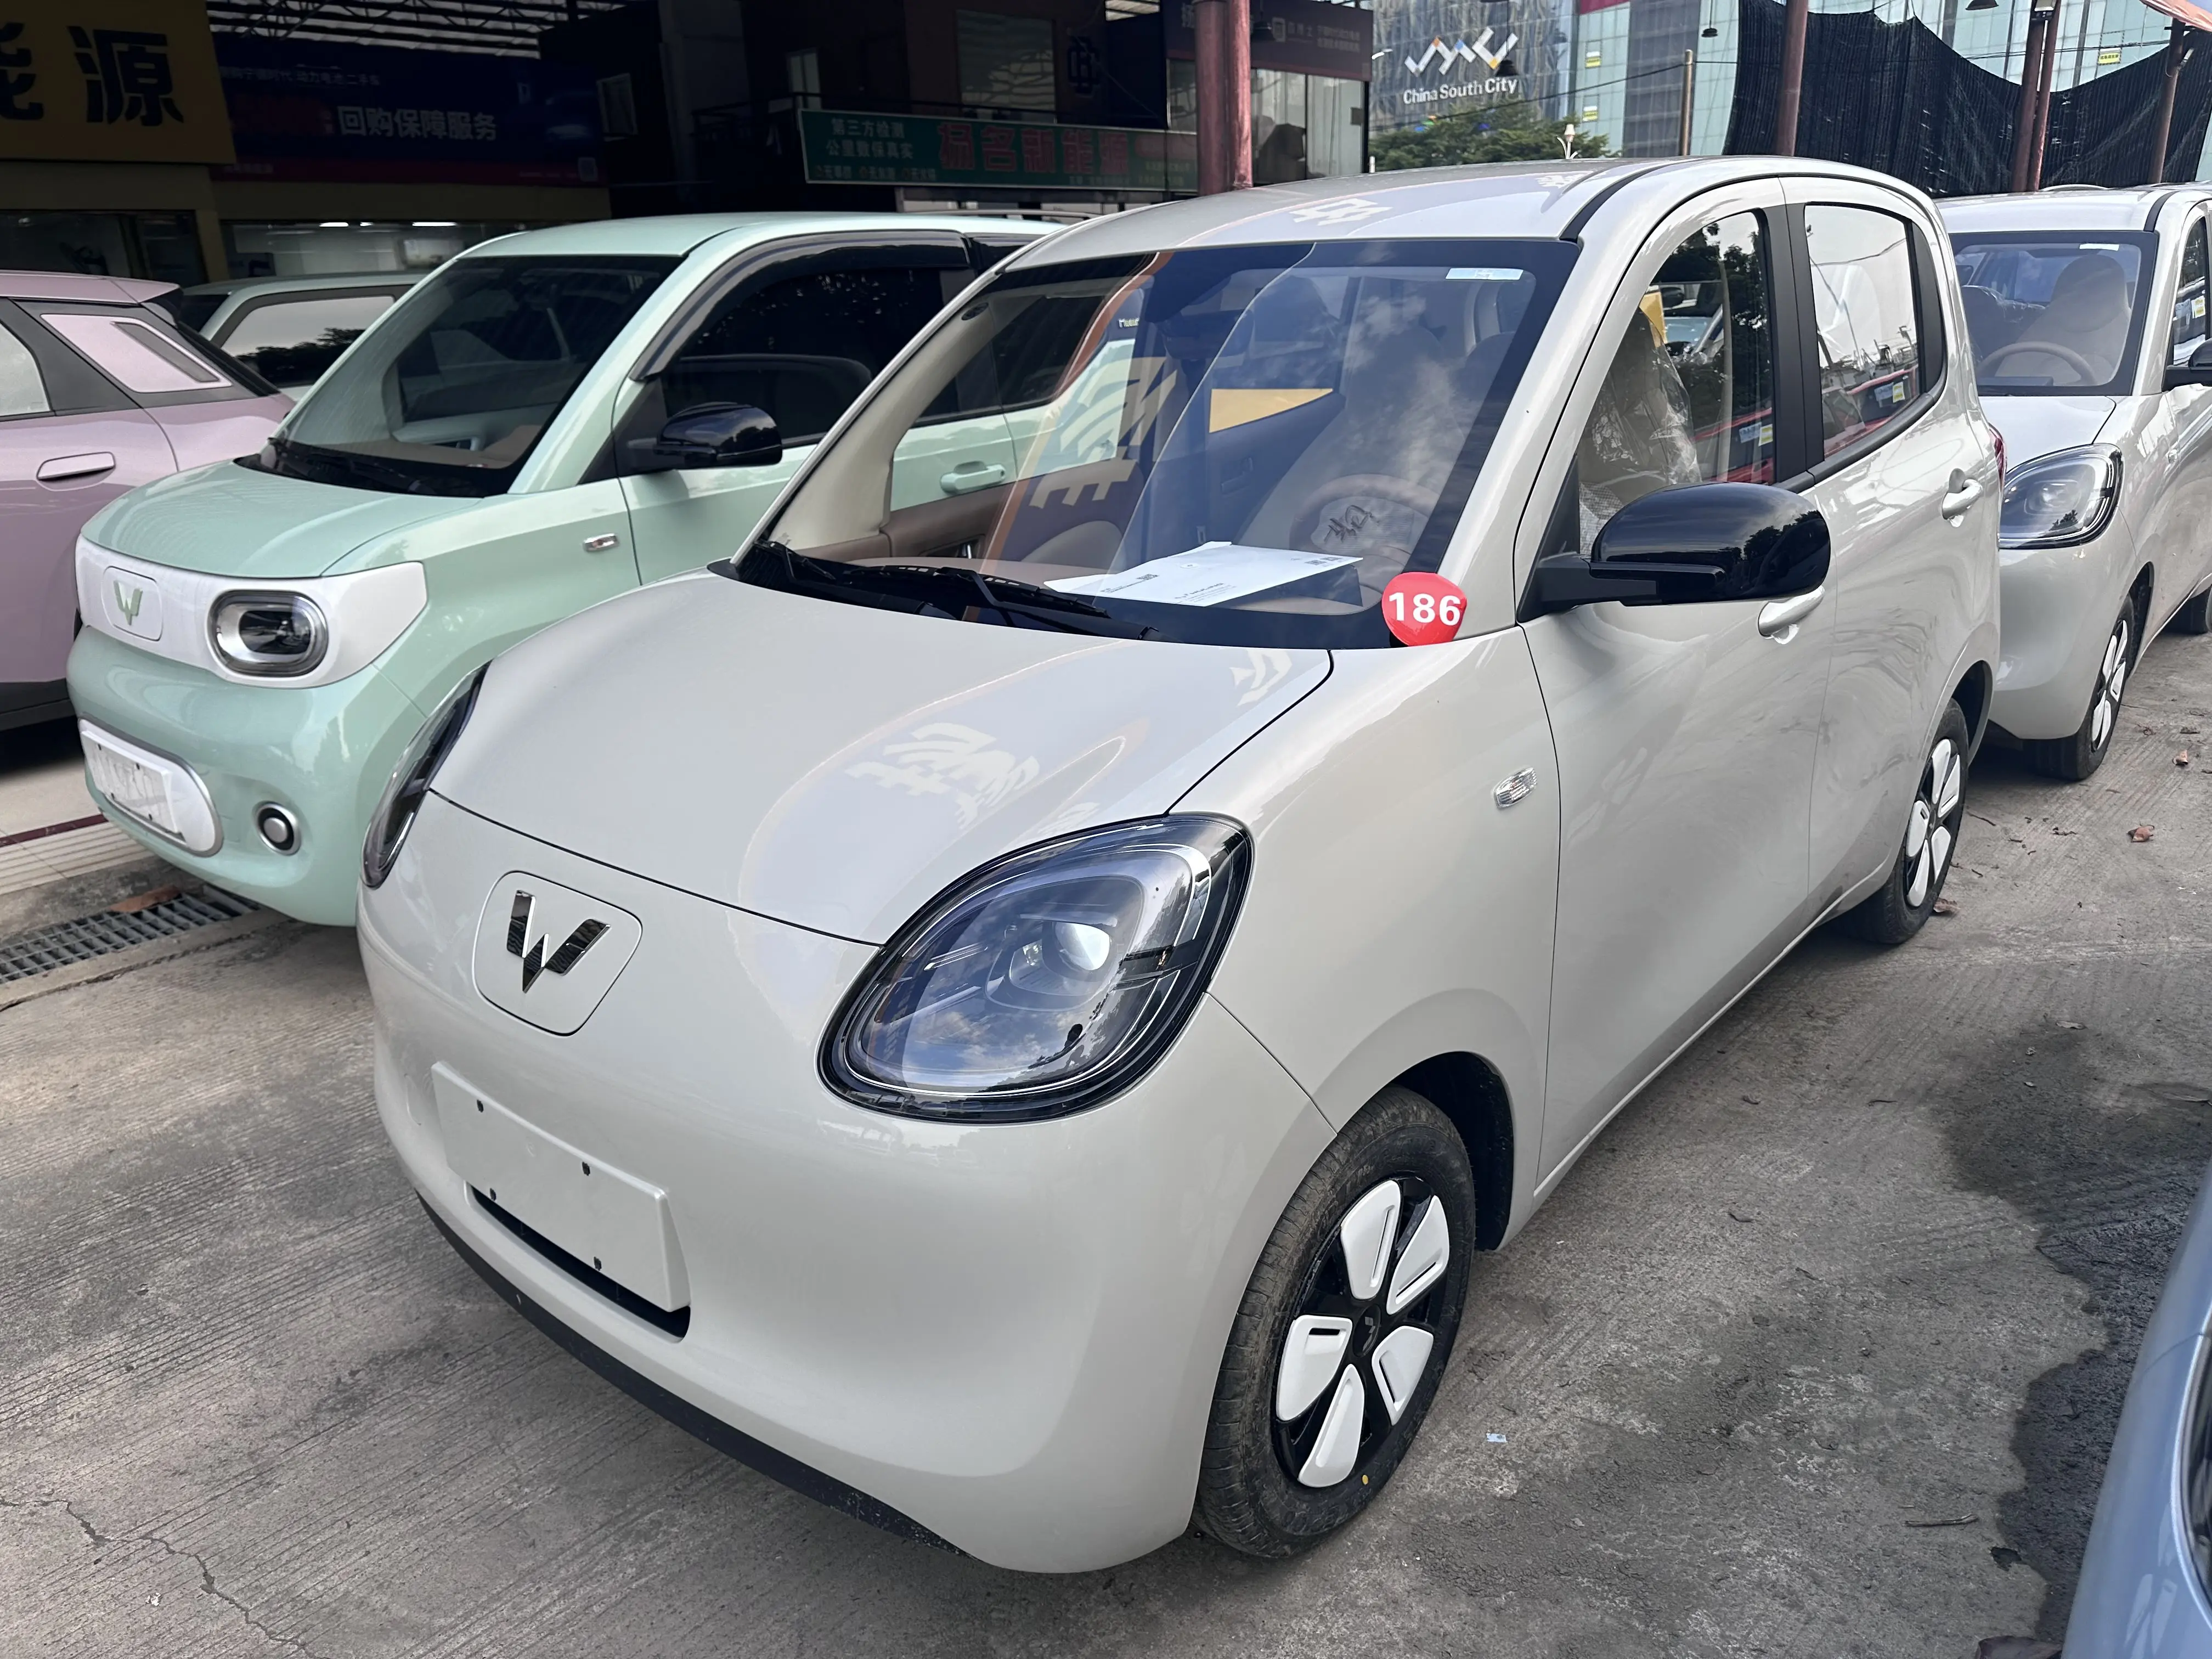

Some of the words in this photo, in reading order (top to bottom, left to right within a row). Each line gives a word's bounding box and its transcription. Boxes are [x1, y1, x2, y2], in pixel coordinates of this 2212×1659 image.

[1403, 88, 1438, 104] China
[1440, 81, 1482, 99] South
[1485, 77, 1518, 94] City
[337, 105, 497, 141] 回购保障服务
[831, 117, 905, 139] 第三方检测
[1389, 592, 1461, 626] 186
